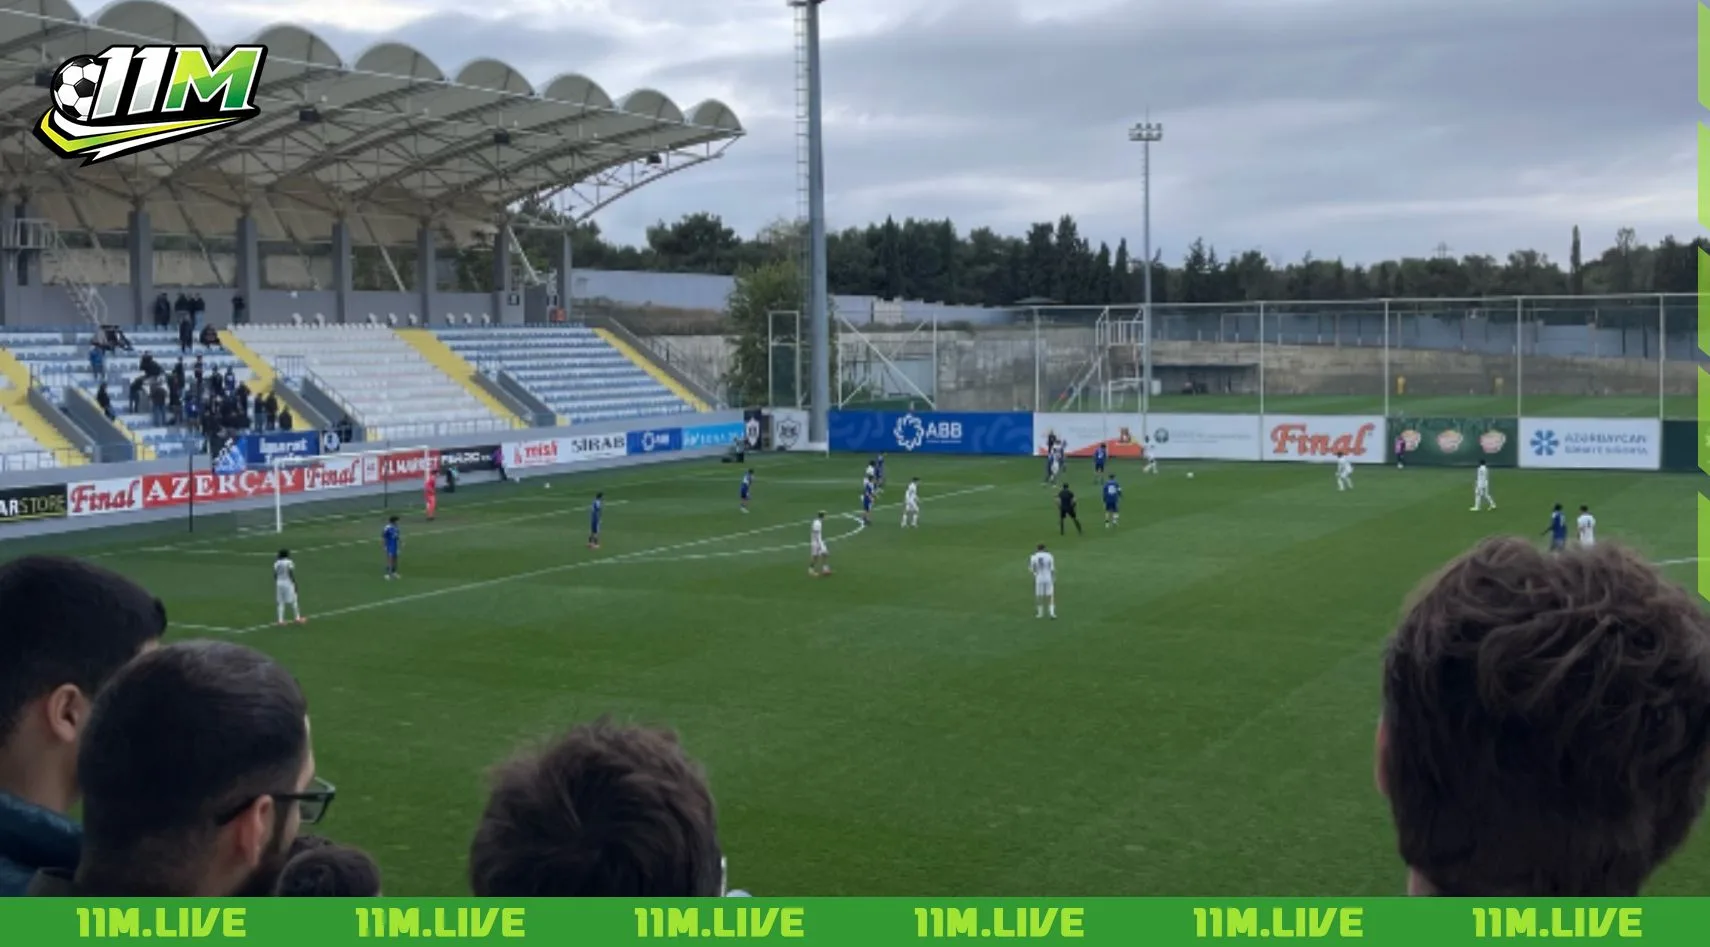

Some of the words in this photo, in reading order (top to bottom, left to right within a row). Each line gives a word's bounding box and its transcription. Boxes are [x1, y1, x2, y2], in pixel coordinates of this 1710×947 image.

[926, 422, 962, 439] ABB
[1271, 423, 1375, 455] Final
[146, 470, 297, 502] AZERÇAY
[307, 458, 360, 488] Final
[71, 480, 140, 512] Final
